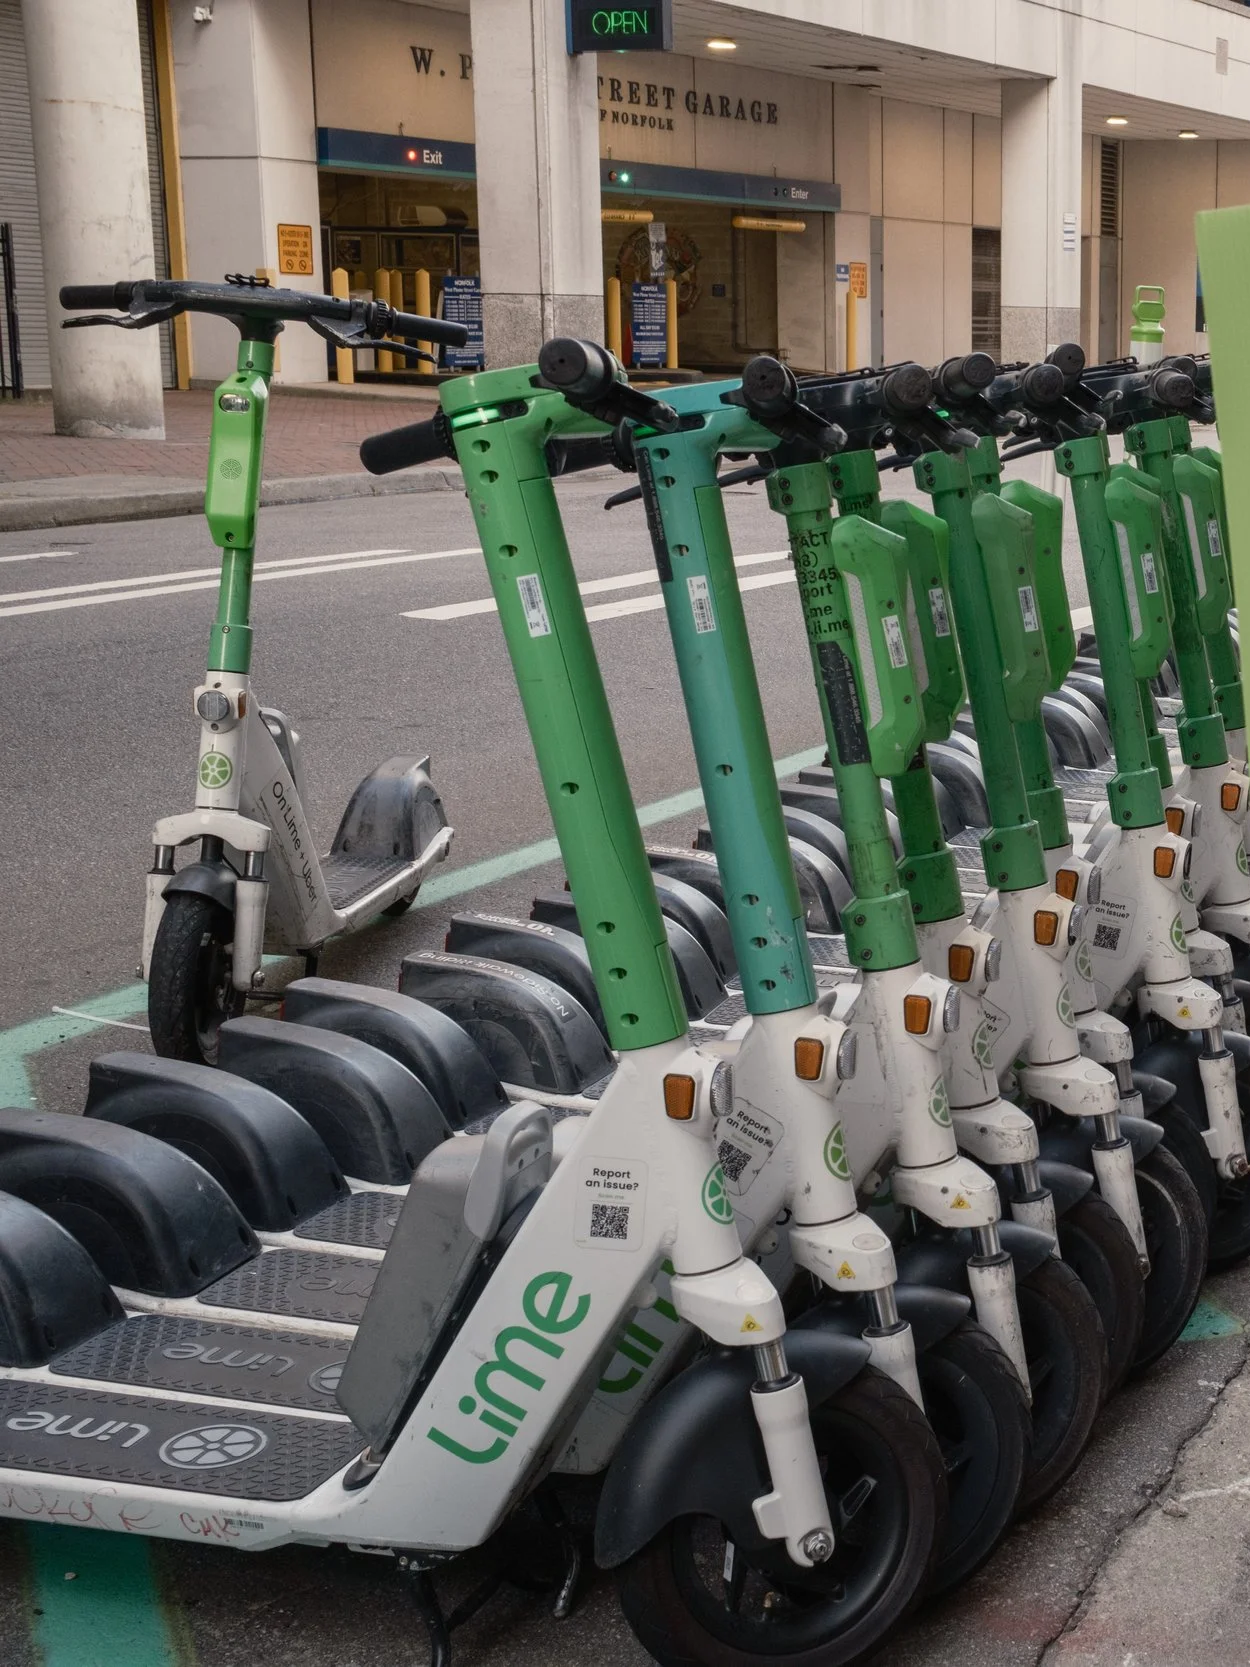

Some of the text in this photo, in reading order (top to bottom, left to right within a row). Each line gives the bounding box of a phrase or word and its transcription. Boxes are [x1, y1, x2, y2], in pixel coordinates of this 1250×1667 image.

[592, 10, 648, 36] OPEN
[685, 90, 778, 125] GARAGE
[611, 110, 674, 131] NORFOLK
[423, 150, 442, 165] Exit
[791, 188, 809, 200] Enter
[283, 804, 301, 851] Lime
[302, 860, 318, 903] Uber
[1101, 899, 1126, 910] Report
[1106, 909, 1130, 919] issue?
[550, 996, 569, 1017] No
[726, 1117, 739, 1129] an
[740, 1123, 774, 1149] issue?
[737, 1110, 772, 1135] Report
[585, 1178, 639, 1191] an issue?
[593, 1167, 631, 1180] Report
[162, 1342, 296, 1378] Lime
[426, 1270, 592, 1464] Lime
[7, 1410, 151, 1449] Lime
